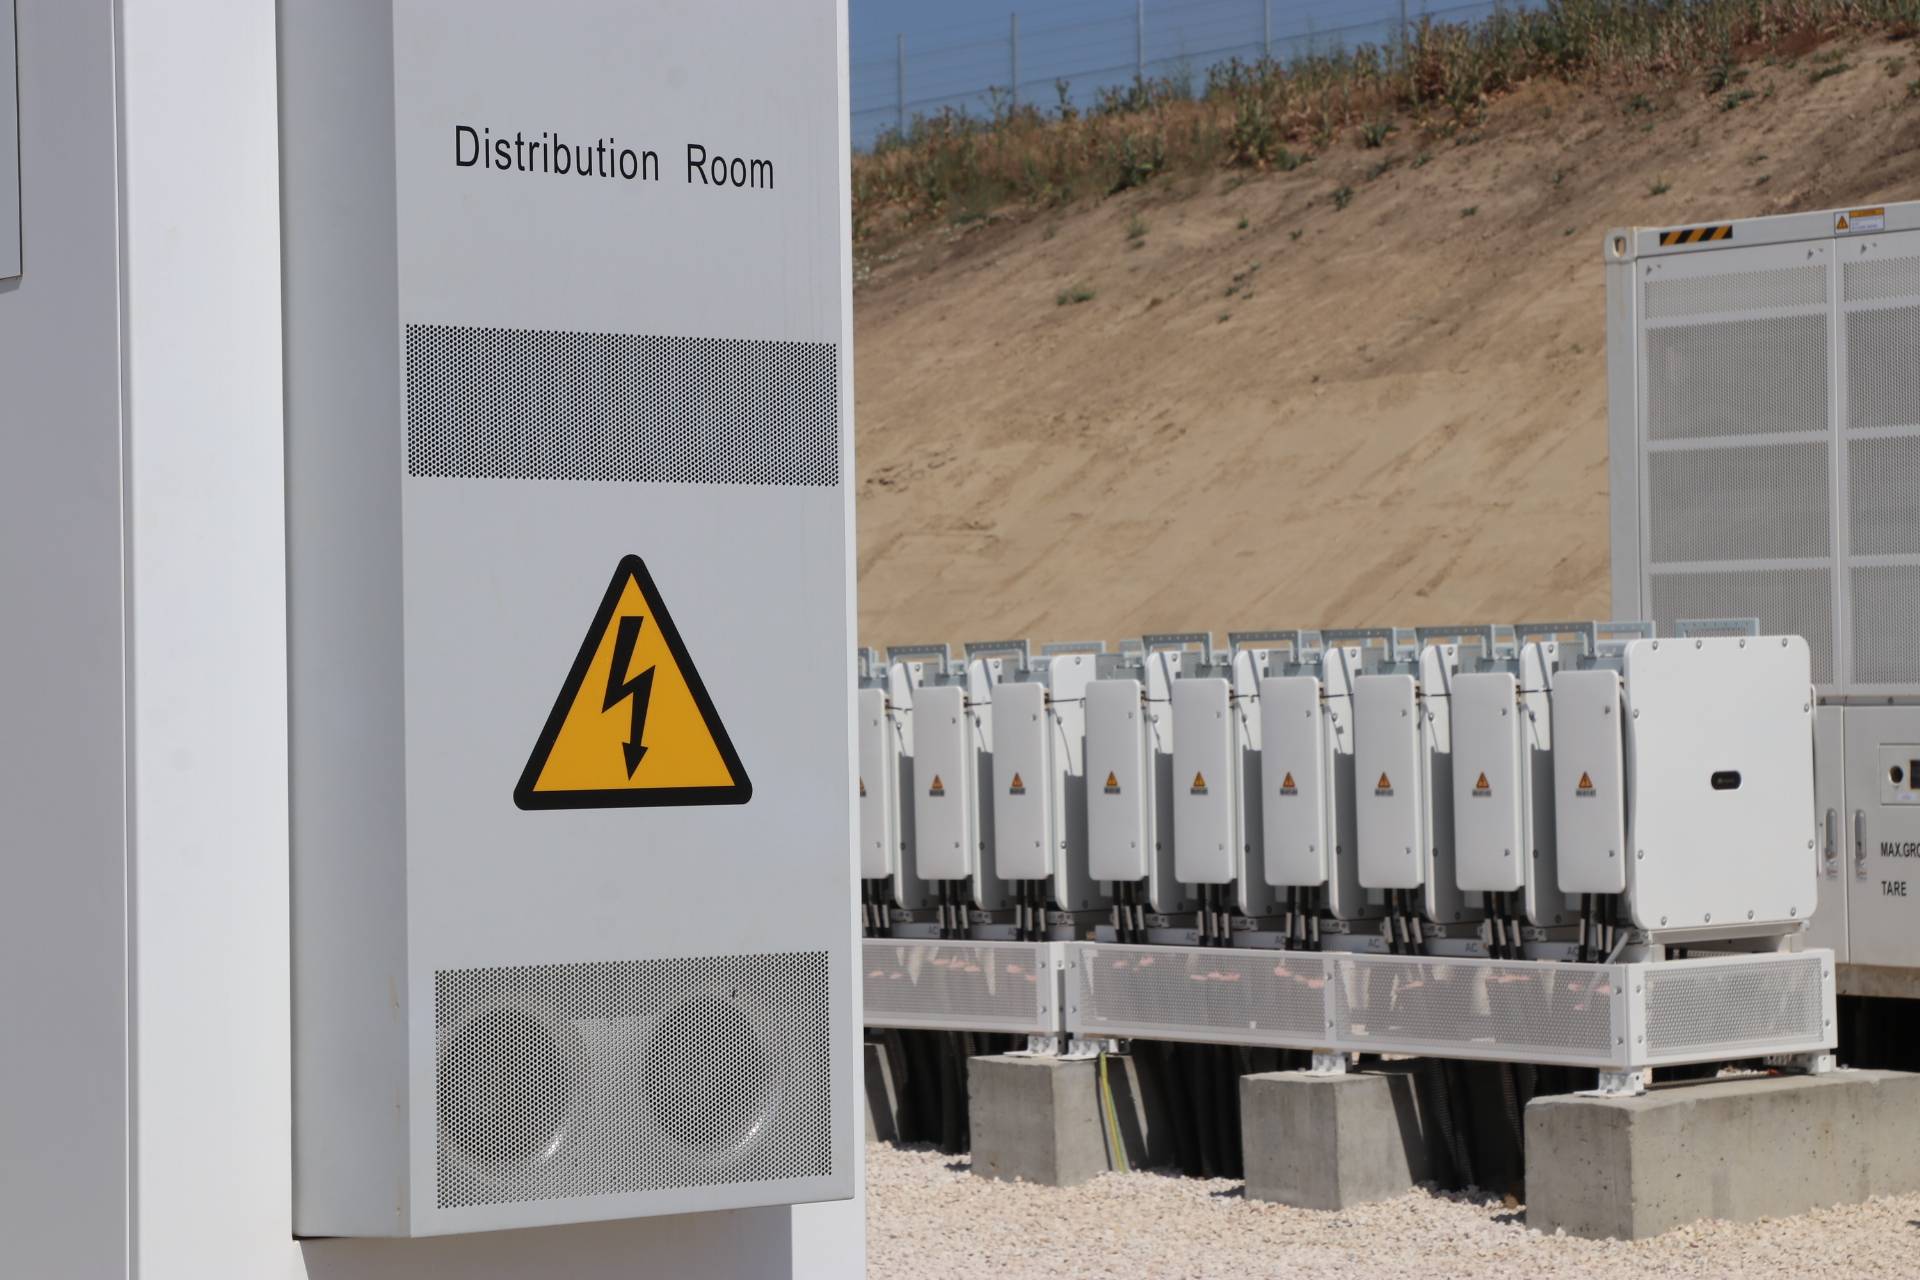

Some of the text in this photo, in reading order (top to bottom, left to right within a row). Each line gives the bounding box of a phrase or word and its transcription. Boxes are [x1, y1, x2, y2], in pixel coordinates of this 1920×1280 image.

[455, 125, 774, 189] Distribution Room
[1881, 880, 1907, 896] TARE
